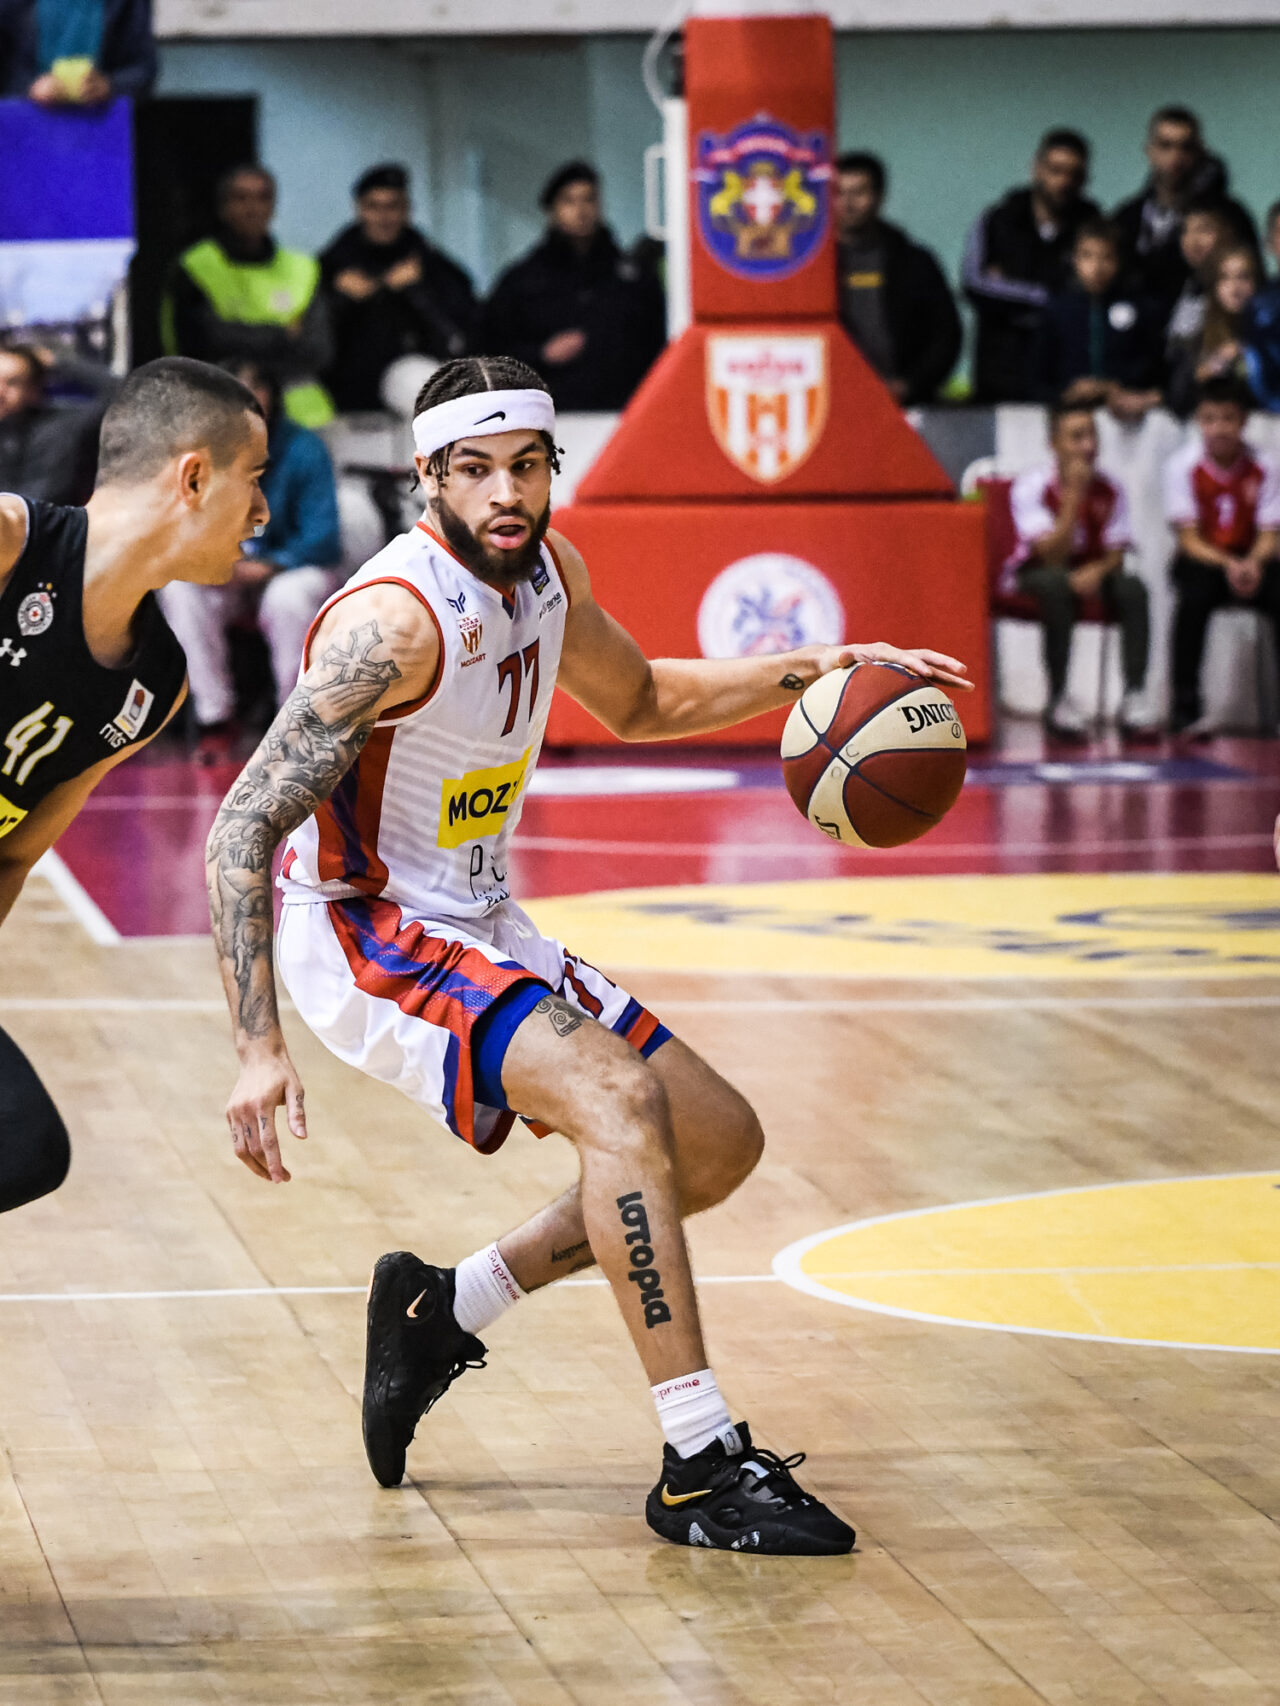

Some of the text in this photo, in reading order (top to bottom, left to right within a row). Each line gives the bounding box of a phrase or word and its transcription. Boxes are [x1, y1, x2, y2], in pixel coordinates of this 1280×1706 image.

[496, 635, 540, 738] 77
[0, 700, 74, 787] 41
[98, 721, 127, 750] mts
[448, 776, 520, 827] MOZ
[486, 1249, 521, 1301] Supreme
[656, 1377, 701, 1401] preme
